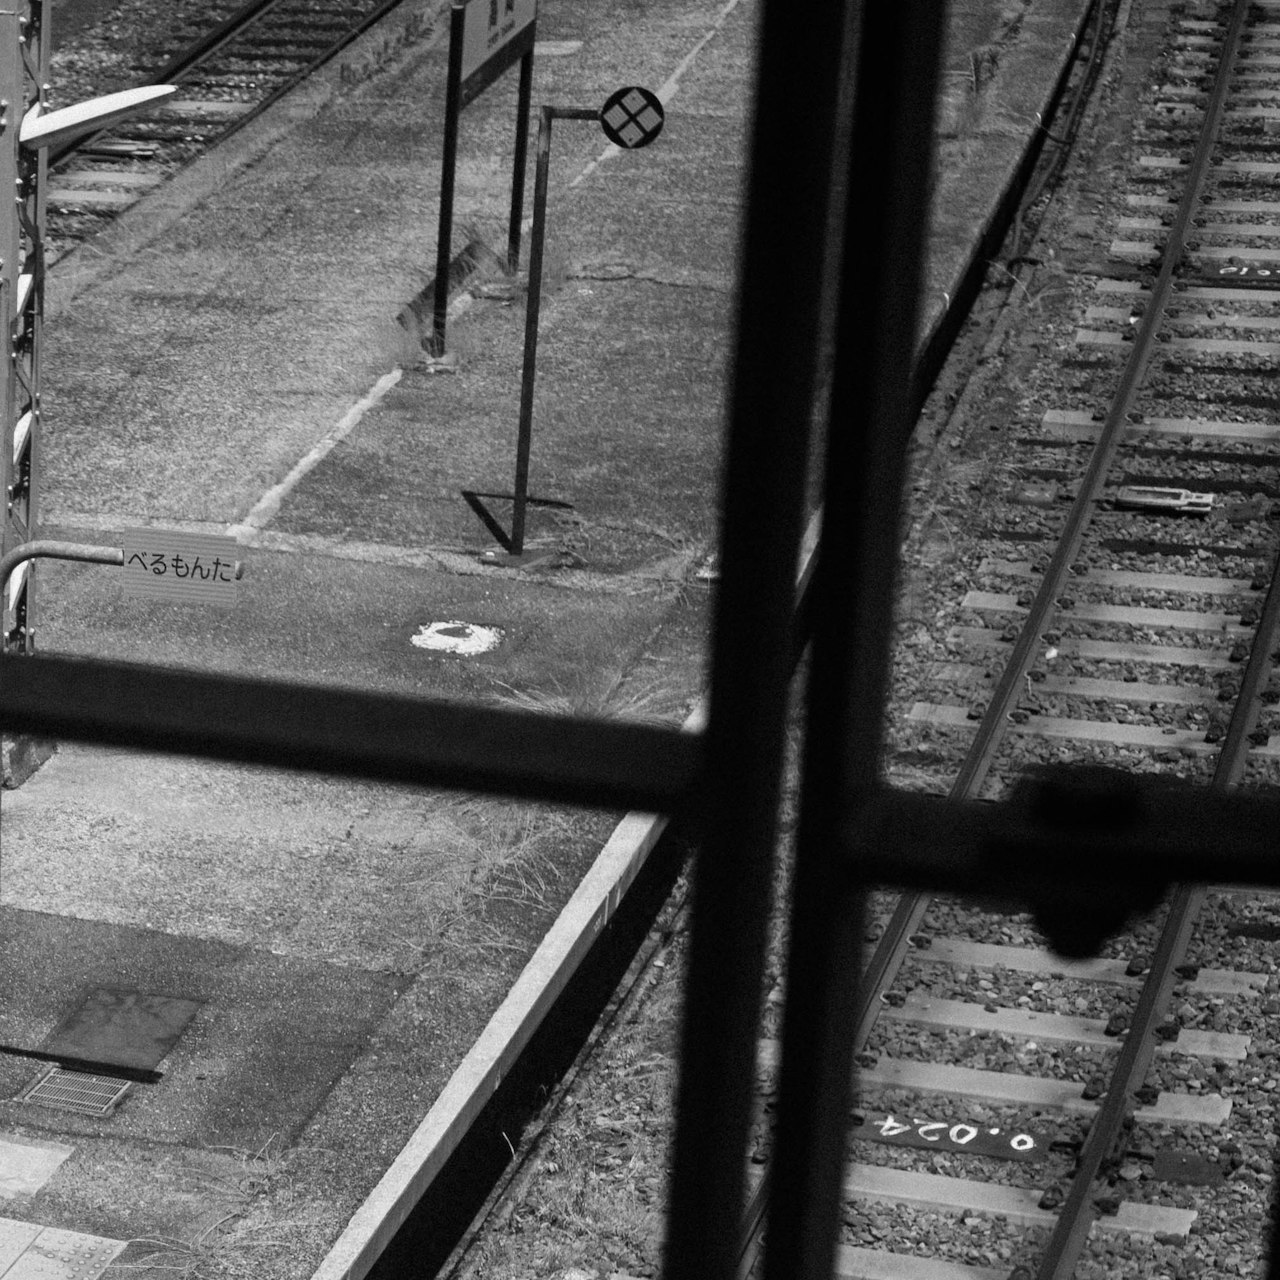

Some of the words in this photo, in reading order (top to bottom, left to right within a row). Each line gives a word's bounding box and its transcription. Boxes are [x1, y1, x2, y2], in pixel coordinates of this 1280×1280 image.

[128, 552, 231, 582] べるもんた
[874, 1114, 1035, 1151] 0.024
